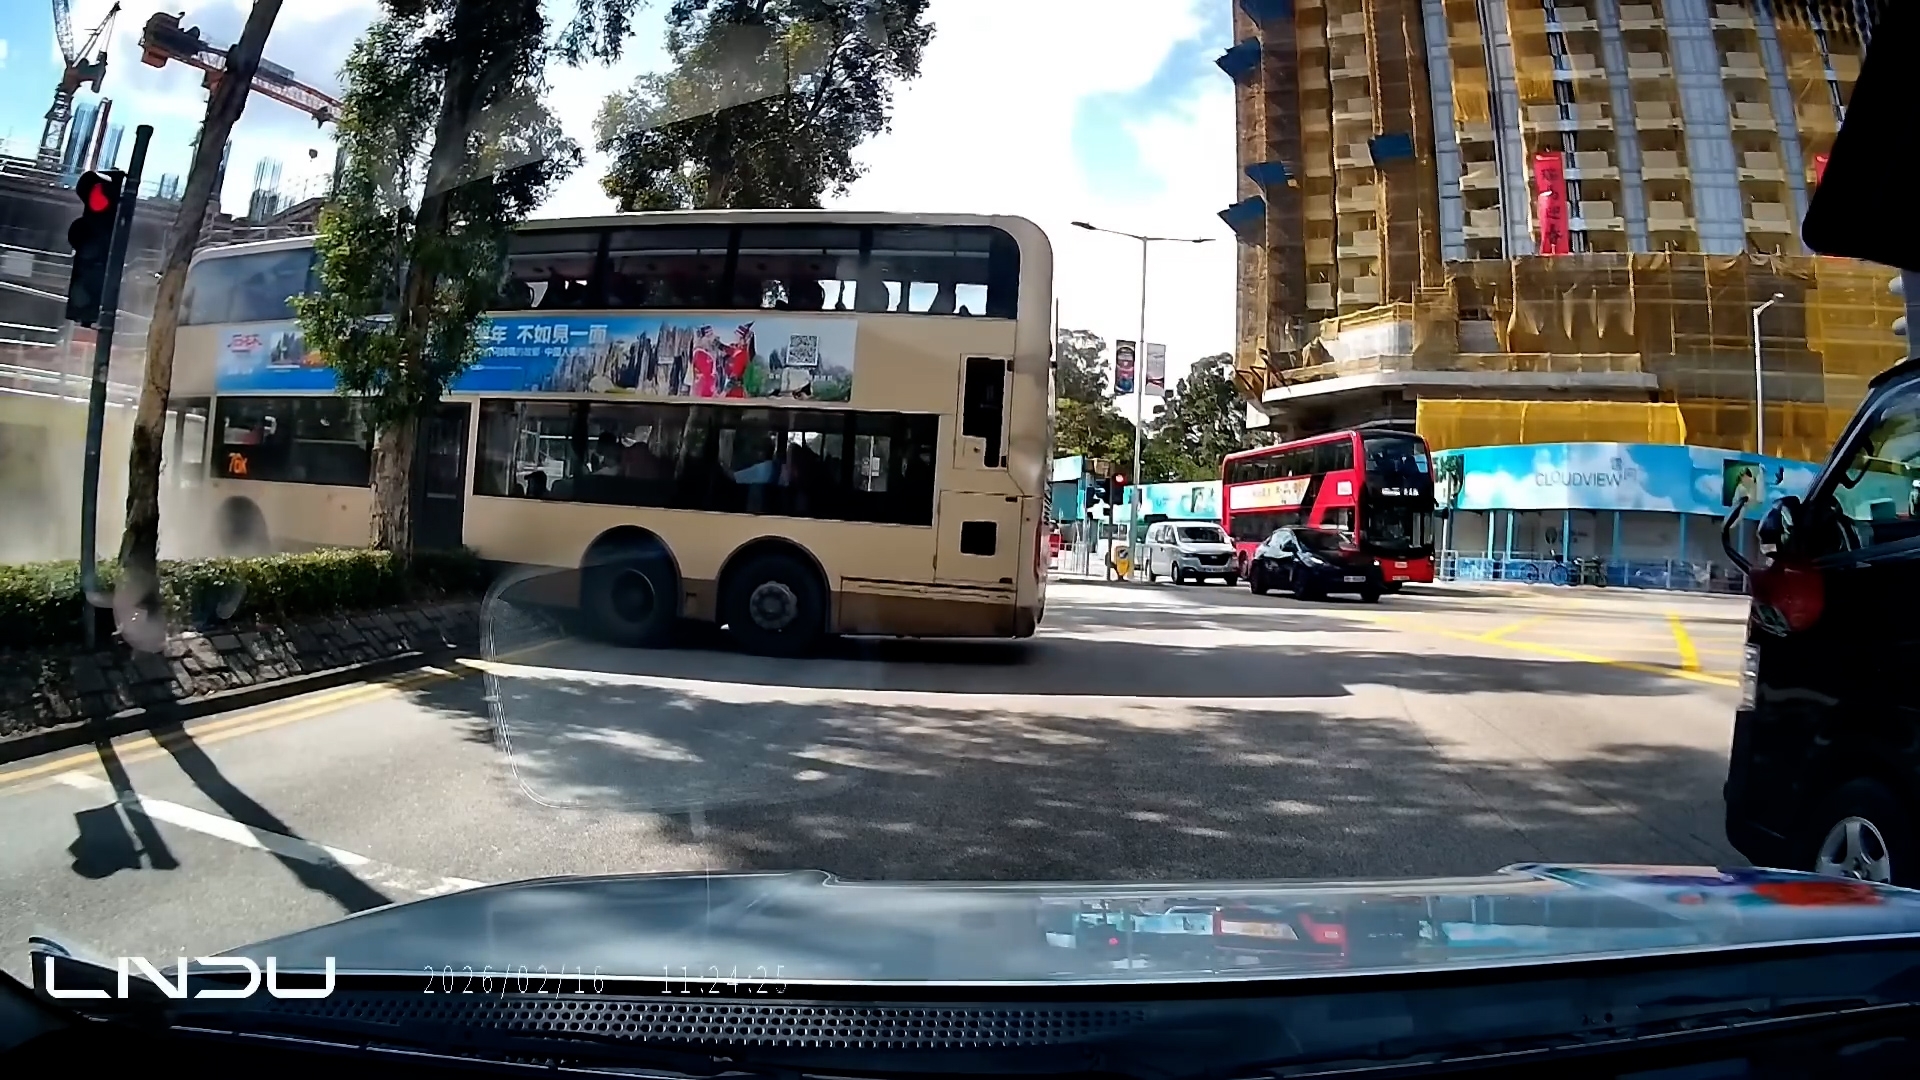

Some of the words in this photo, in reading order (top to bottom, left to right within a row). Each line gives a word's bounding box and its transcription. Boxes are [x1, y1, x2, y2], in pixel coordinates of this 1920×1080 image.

[517, 324, 608, 345] 不如見一面
[1535, 470, 1622, 487] CLOUDVIEW
